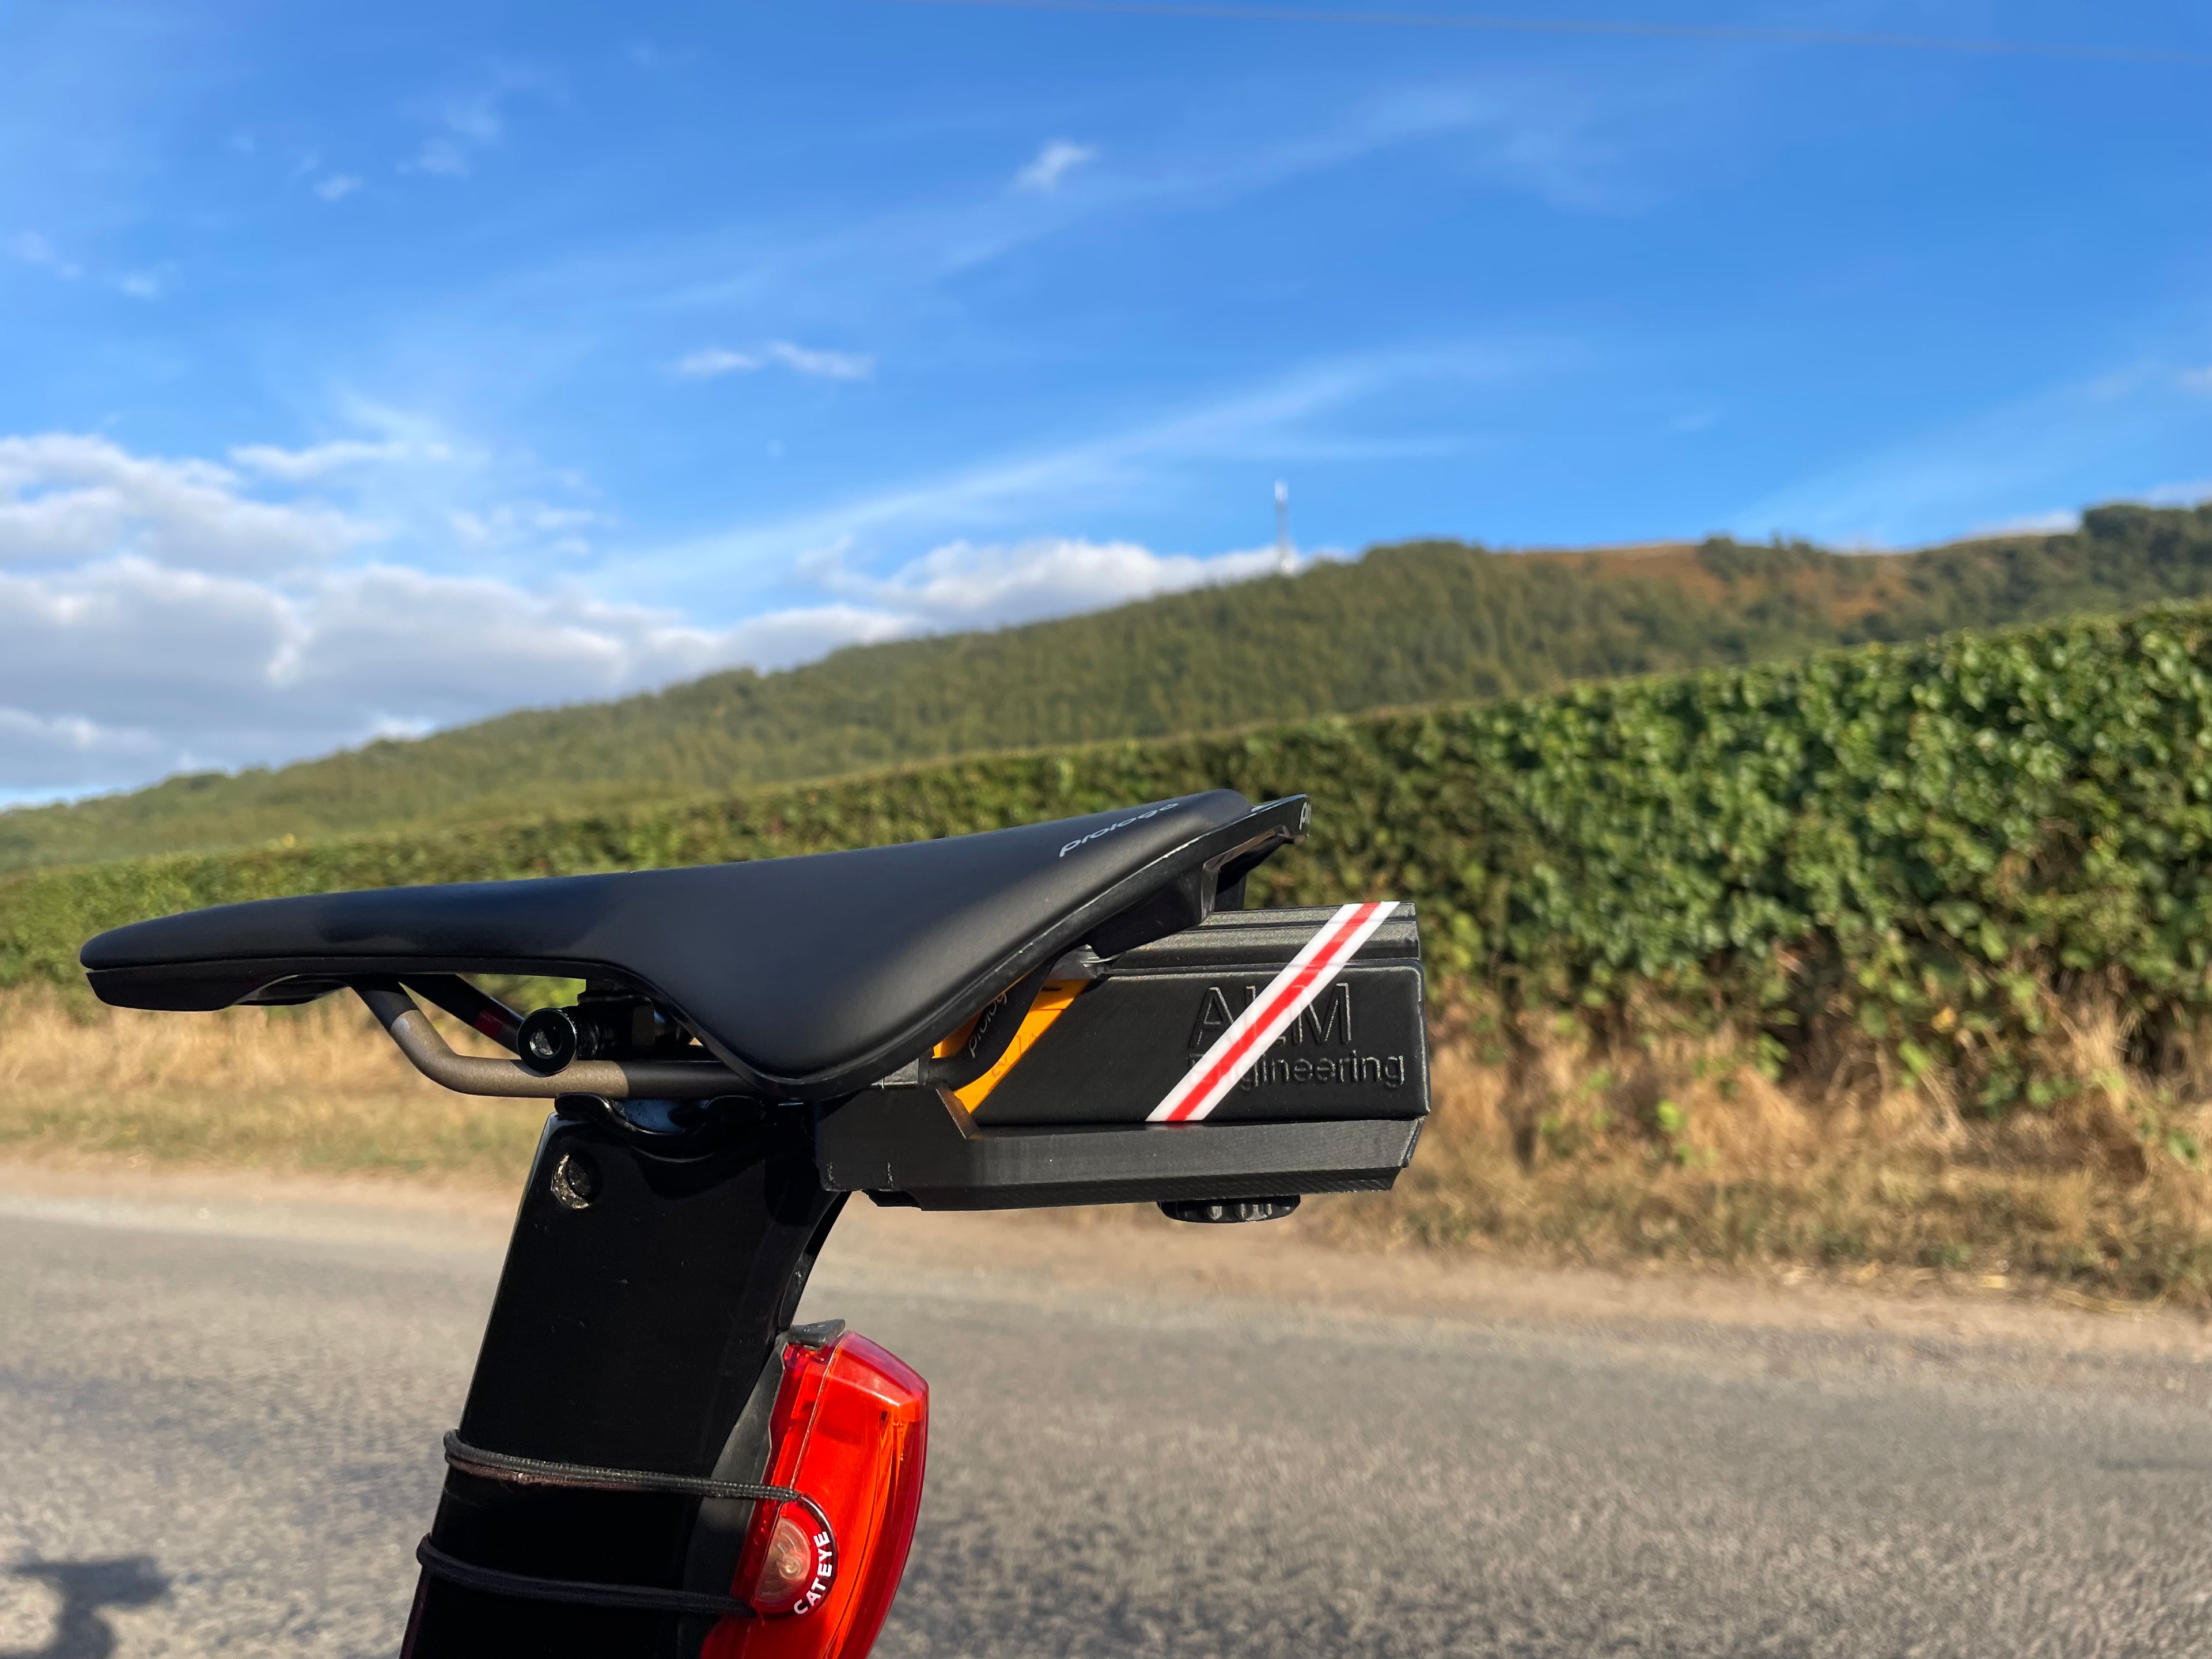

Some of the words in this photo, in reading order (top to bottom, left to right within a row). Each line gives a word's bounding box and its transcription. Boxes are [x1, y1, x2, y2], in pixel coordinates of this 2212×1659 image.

[1059, 803, 1178, 857] prologo
[1188, 1050, 1406, 1091] gineering
[794, 1531, 832, 1614] CATEYE
